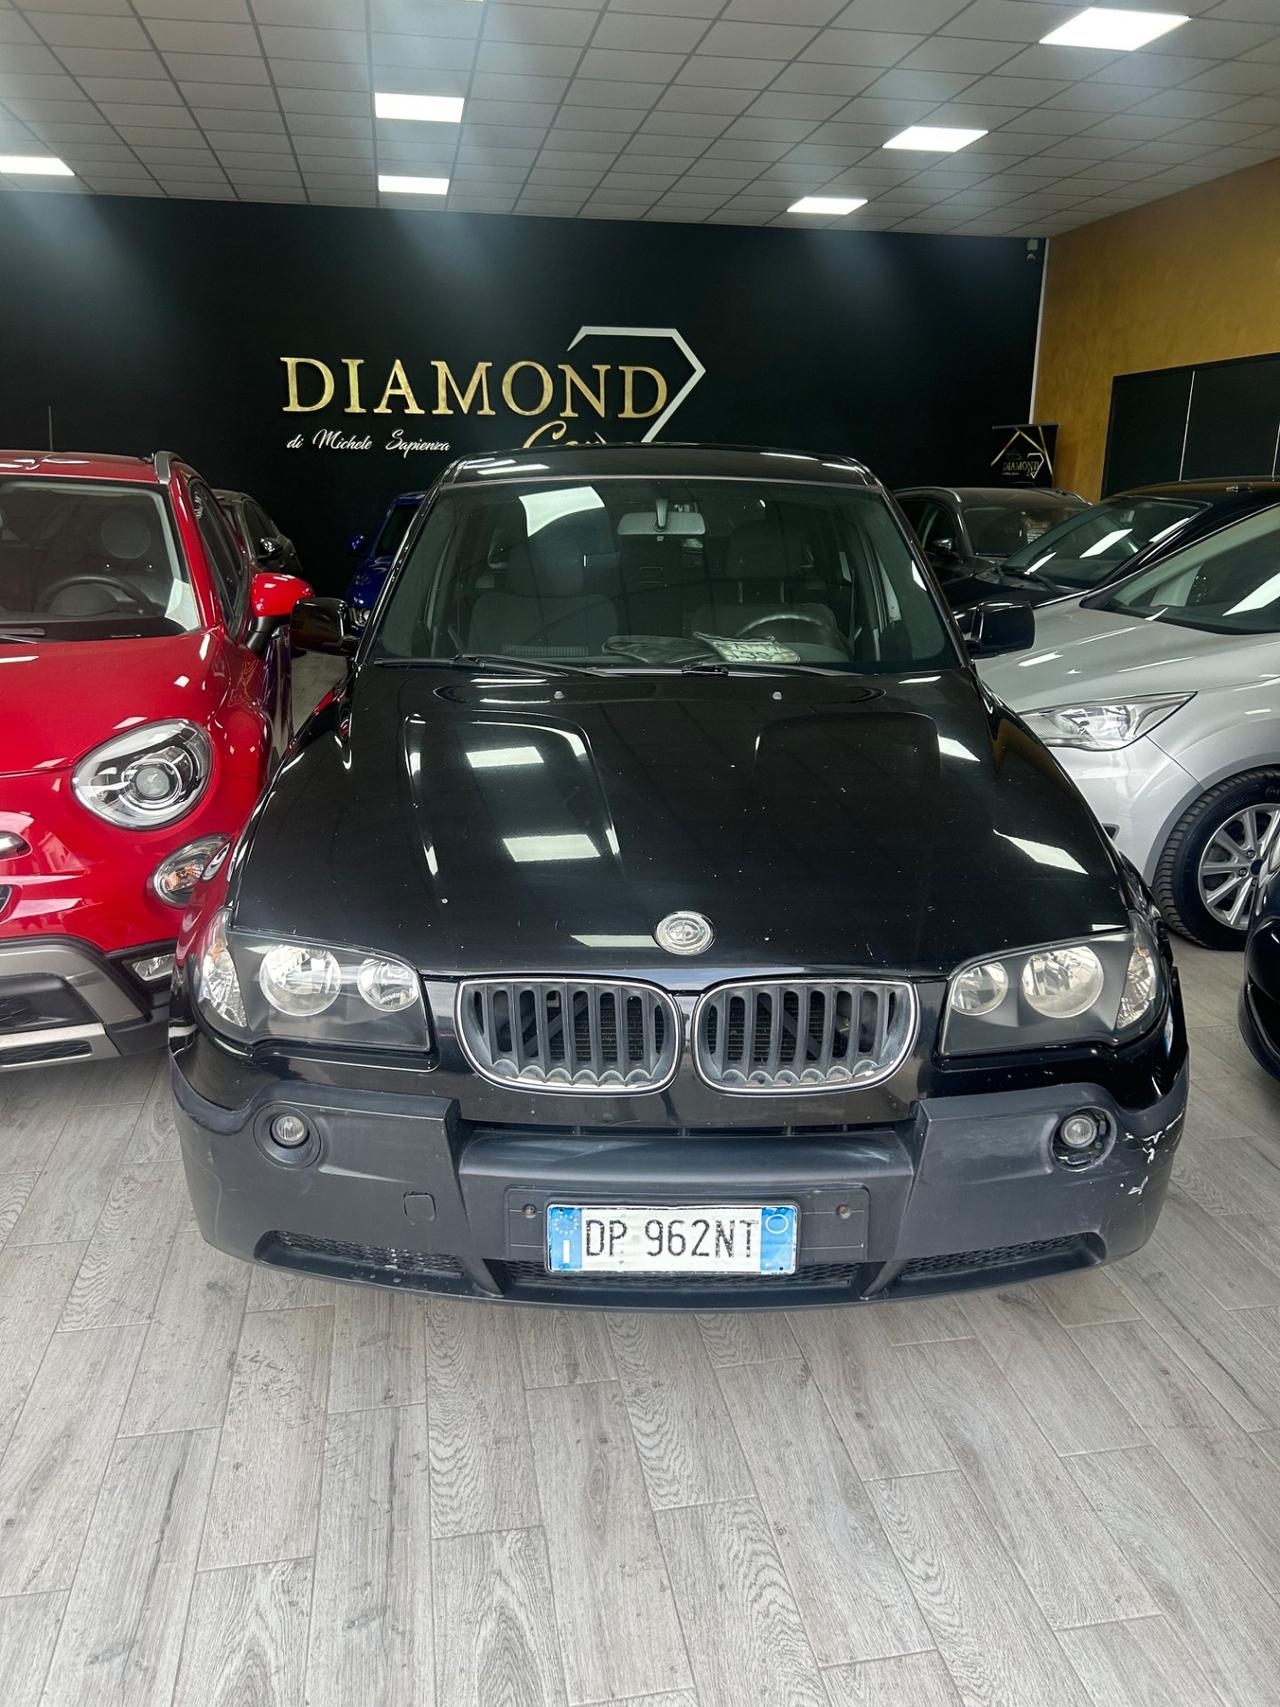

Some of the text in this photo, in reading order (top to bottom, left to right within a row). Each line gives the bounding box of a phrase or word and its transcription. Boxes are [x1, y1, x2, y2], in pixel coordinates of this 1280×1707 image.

[279, 356, 669, 420] DIAMOND
[286, 428, 451, 459] di Michele Sapienza
[1003, 461, 1040, 471] DIAMOND
[585, 1219, 759, 1258] DP 962NT
